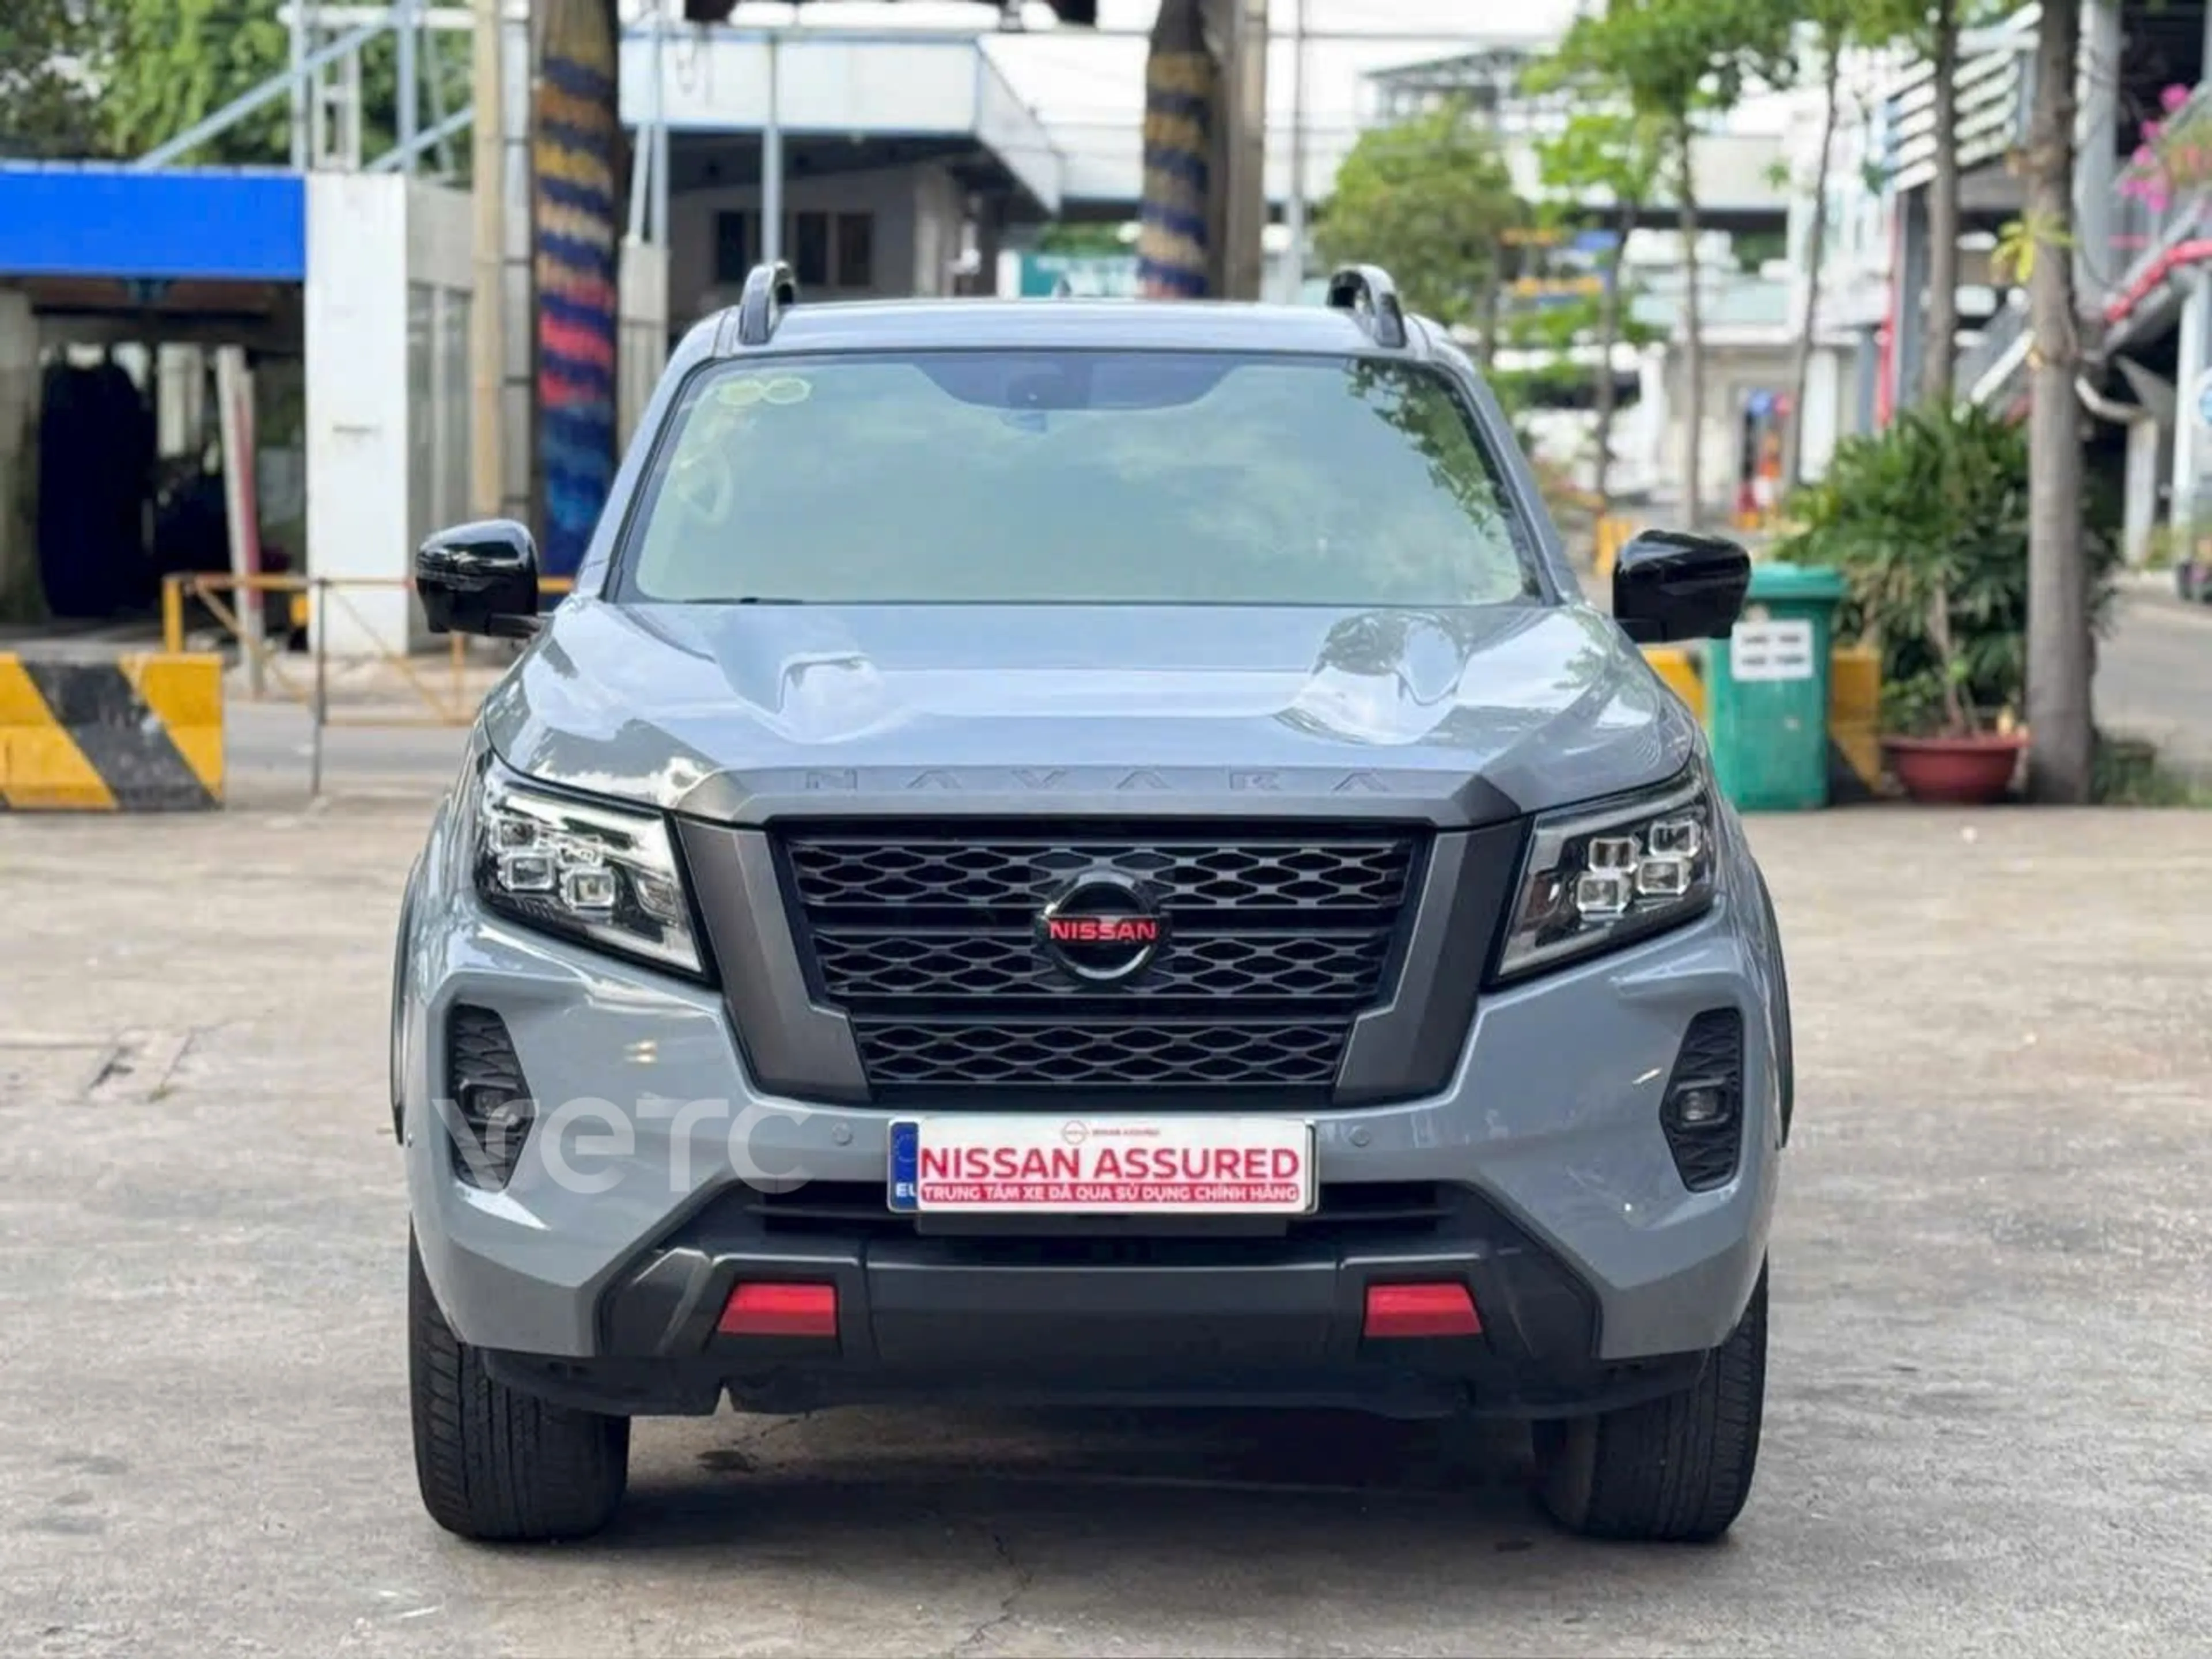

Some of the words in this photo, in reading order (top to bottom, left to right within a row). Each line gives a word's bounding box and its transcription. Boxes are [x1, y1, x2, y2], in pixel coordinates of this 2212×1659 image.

[806, 768, 1390, 791] NAVARA
[1050, 921, 1156, 940] NISSAN
[921, 1147, 1080, 1179] NISSAN
[1094, 1147, 1300, 1179] ASSURED
[923, 1185, 981, 1200] TRUNG
[1023, 1185, 1045, 1200] XE
[1075, 1185, 1112, 1200] QUA
